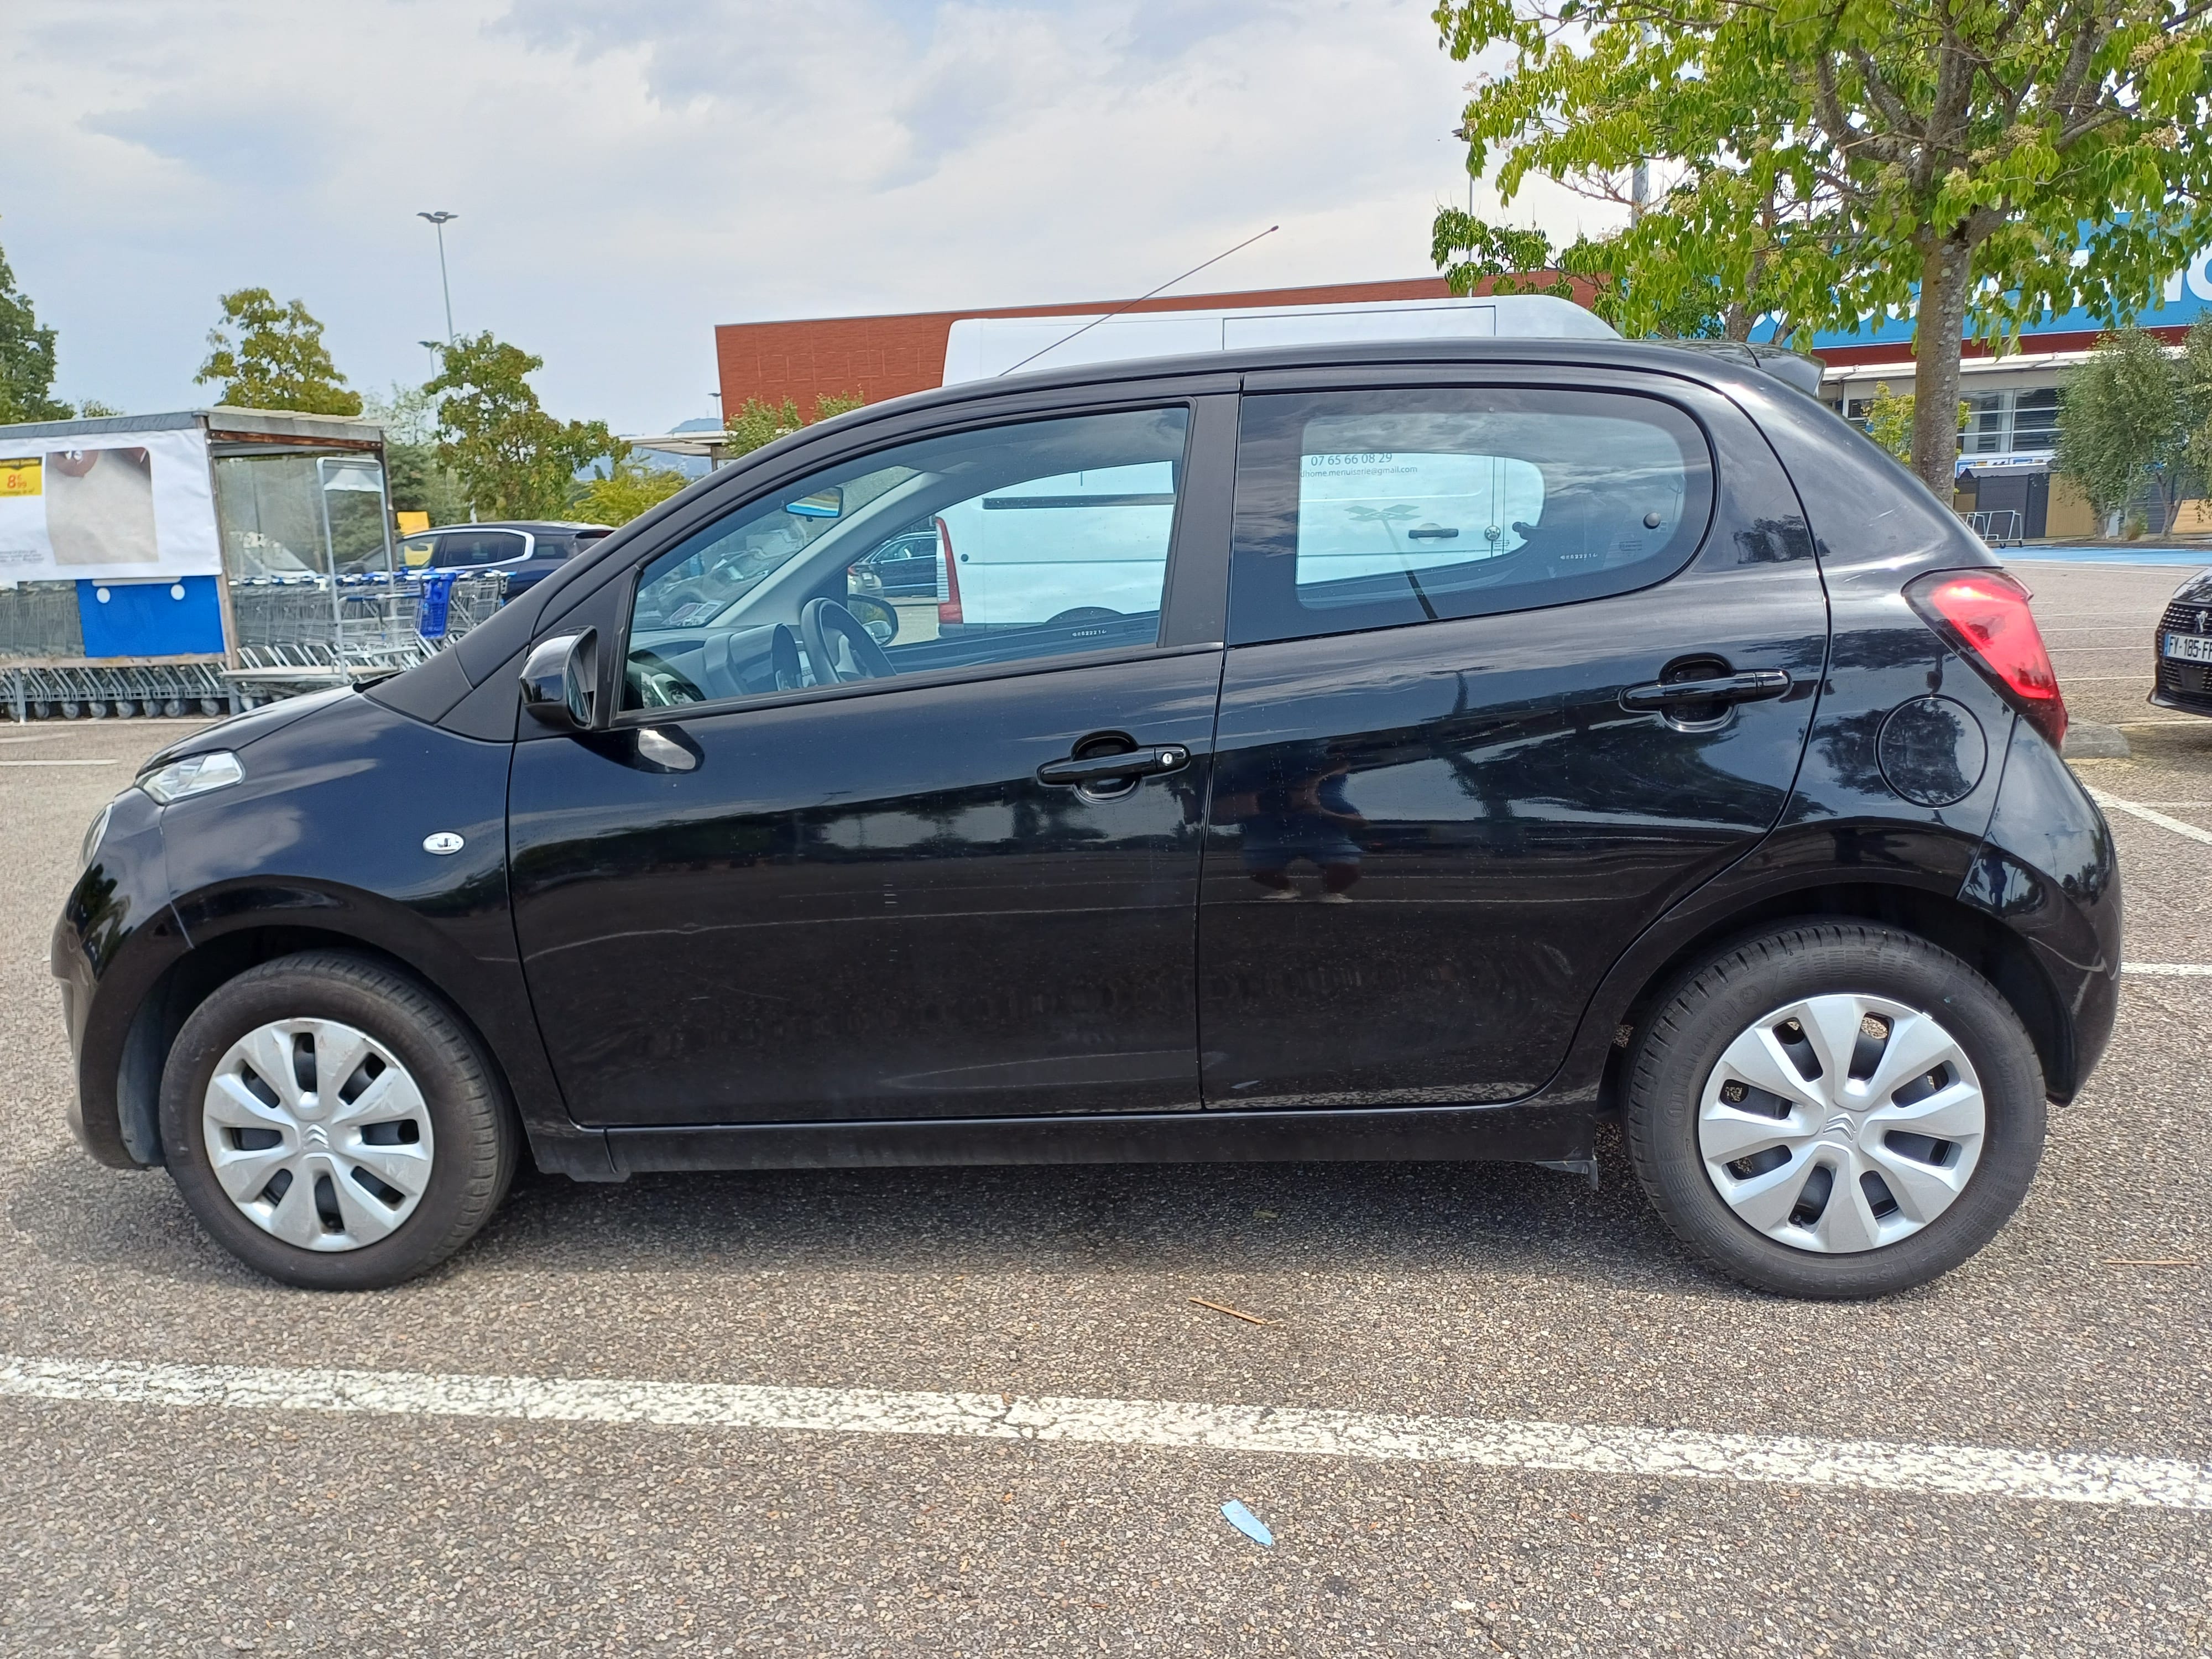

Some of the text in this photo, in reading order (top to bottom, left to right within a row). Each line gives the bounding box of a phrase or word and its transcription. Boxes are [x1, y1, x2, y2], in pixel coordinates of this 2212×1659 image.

[1311, 453, 1392, 466] 07 65 66 08 29
